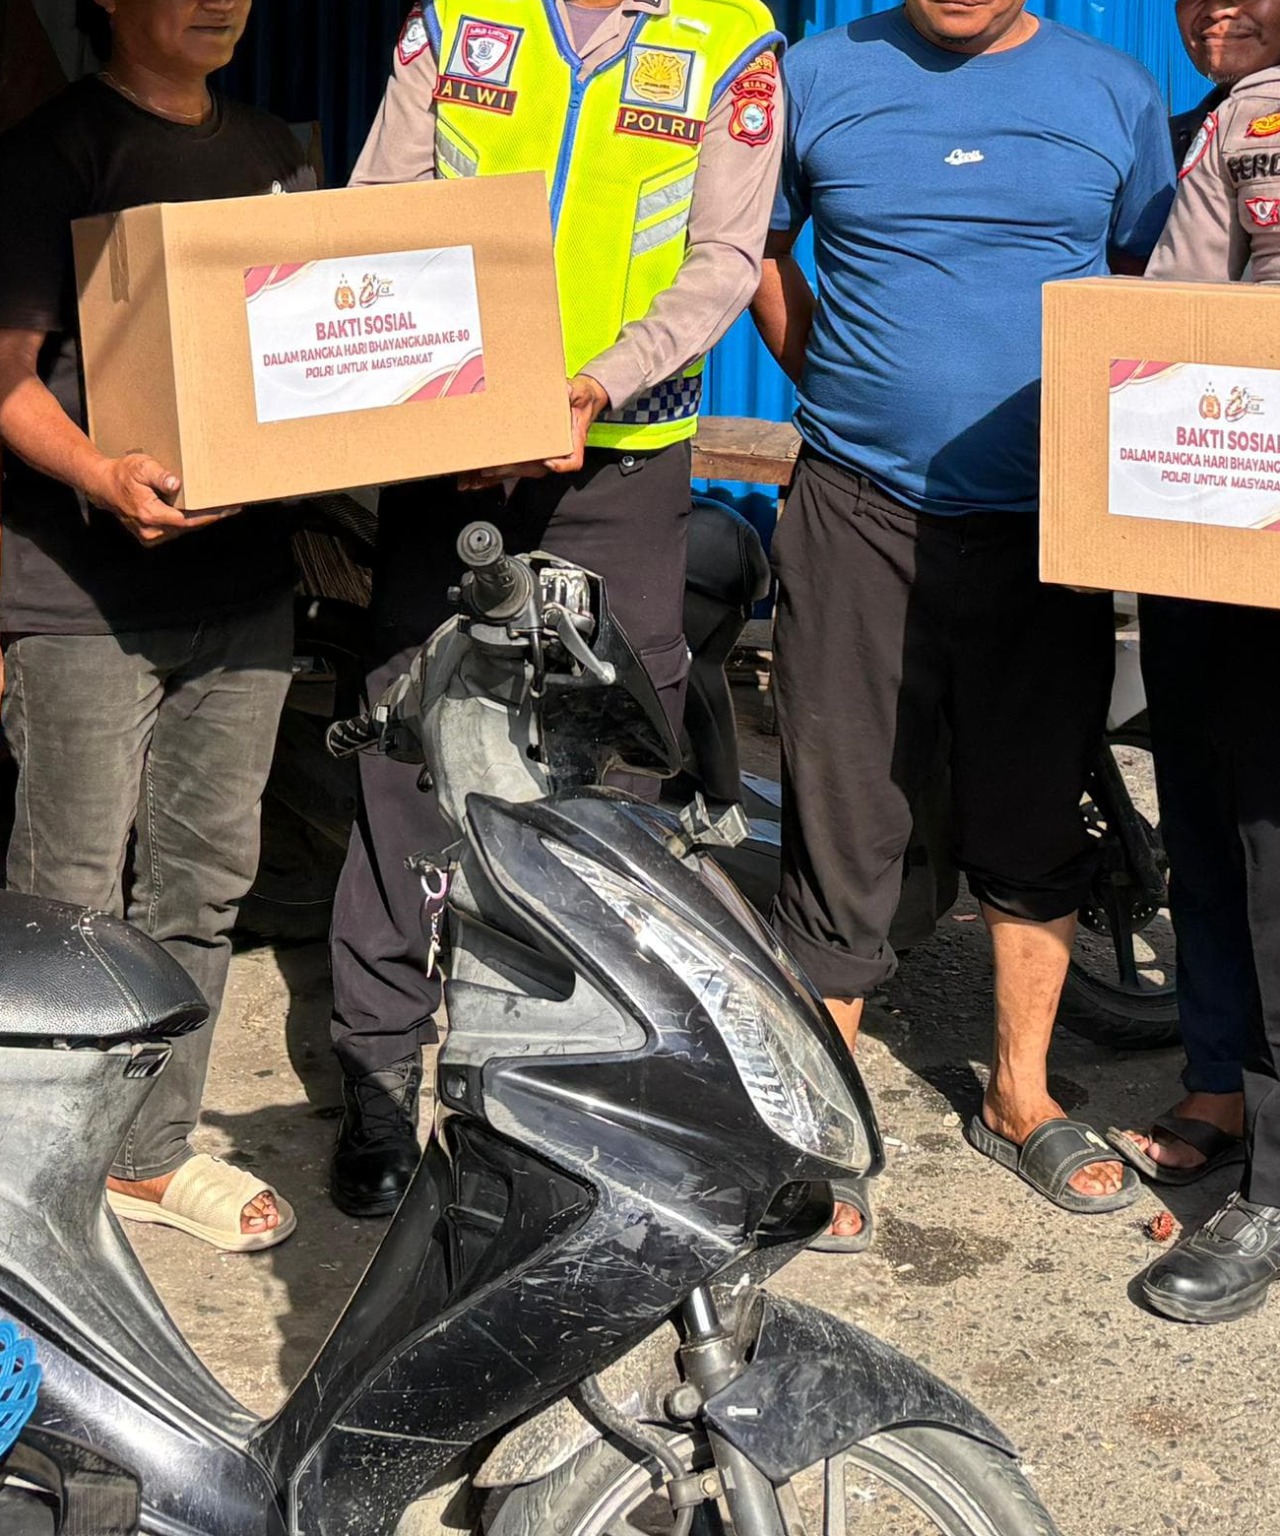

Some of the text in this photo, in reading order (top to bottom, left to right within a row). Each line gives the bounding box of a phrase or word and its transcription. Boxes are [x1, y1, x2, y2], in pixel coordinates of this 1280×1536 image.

[441, 79, 509, 109] ALWI
[622, 110, 695, 140] POLRI
[315, 311, 417, 341] BAKTI SOSIAL
[263, 329, 470, 367] DALAM RANGKA HARI BHAYANGKARA KE-80
[305, 352, 434, 380] POLRI UNTUK MASYARAKAT
[1176, 426, 1224, 449] BAKTI
[1120, 447, 1156, 463] DALAM
[1158, 451, 1201, 468] RANGKA
[1203, 455, 1228, 470] HARI
[1161, 470, 1190, 484] POLRI
[1194, 473, 1228, 488] UNTUK
